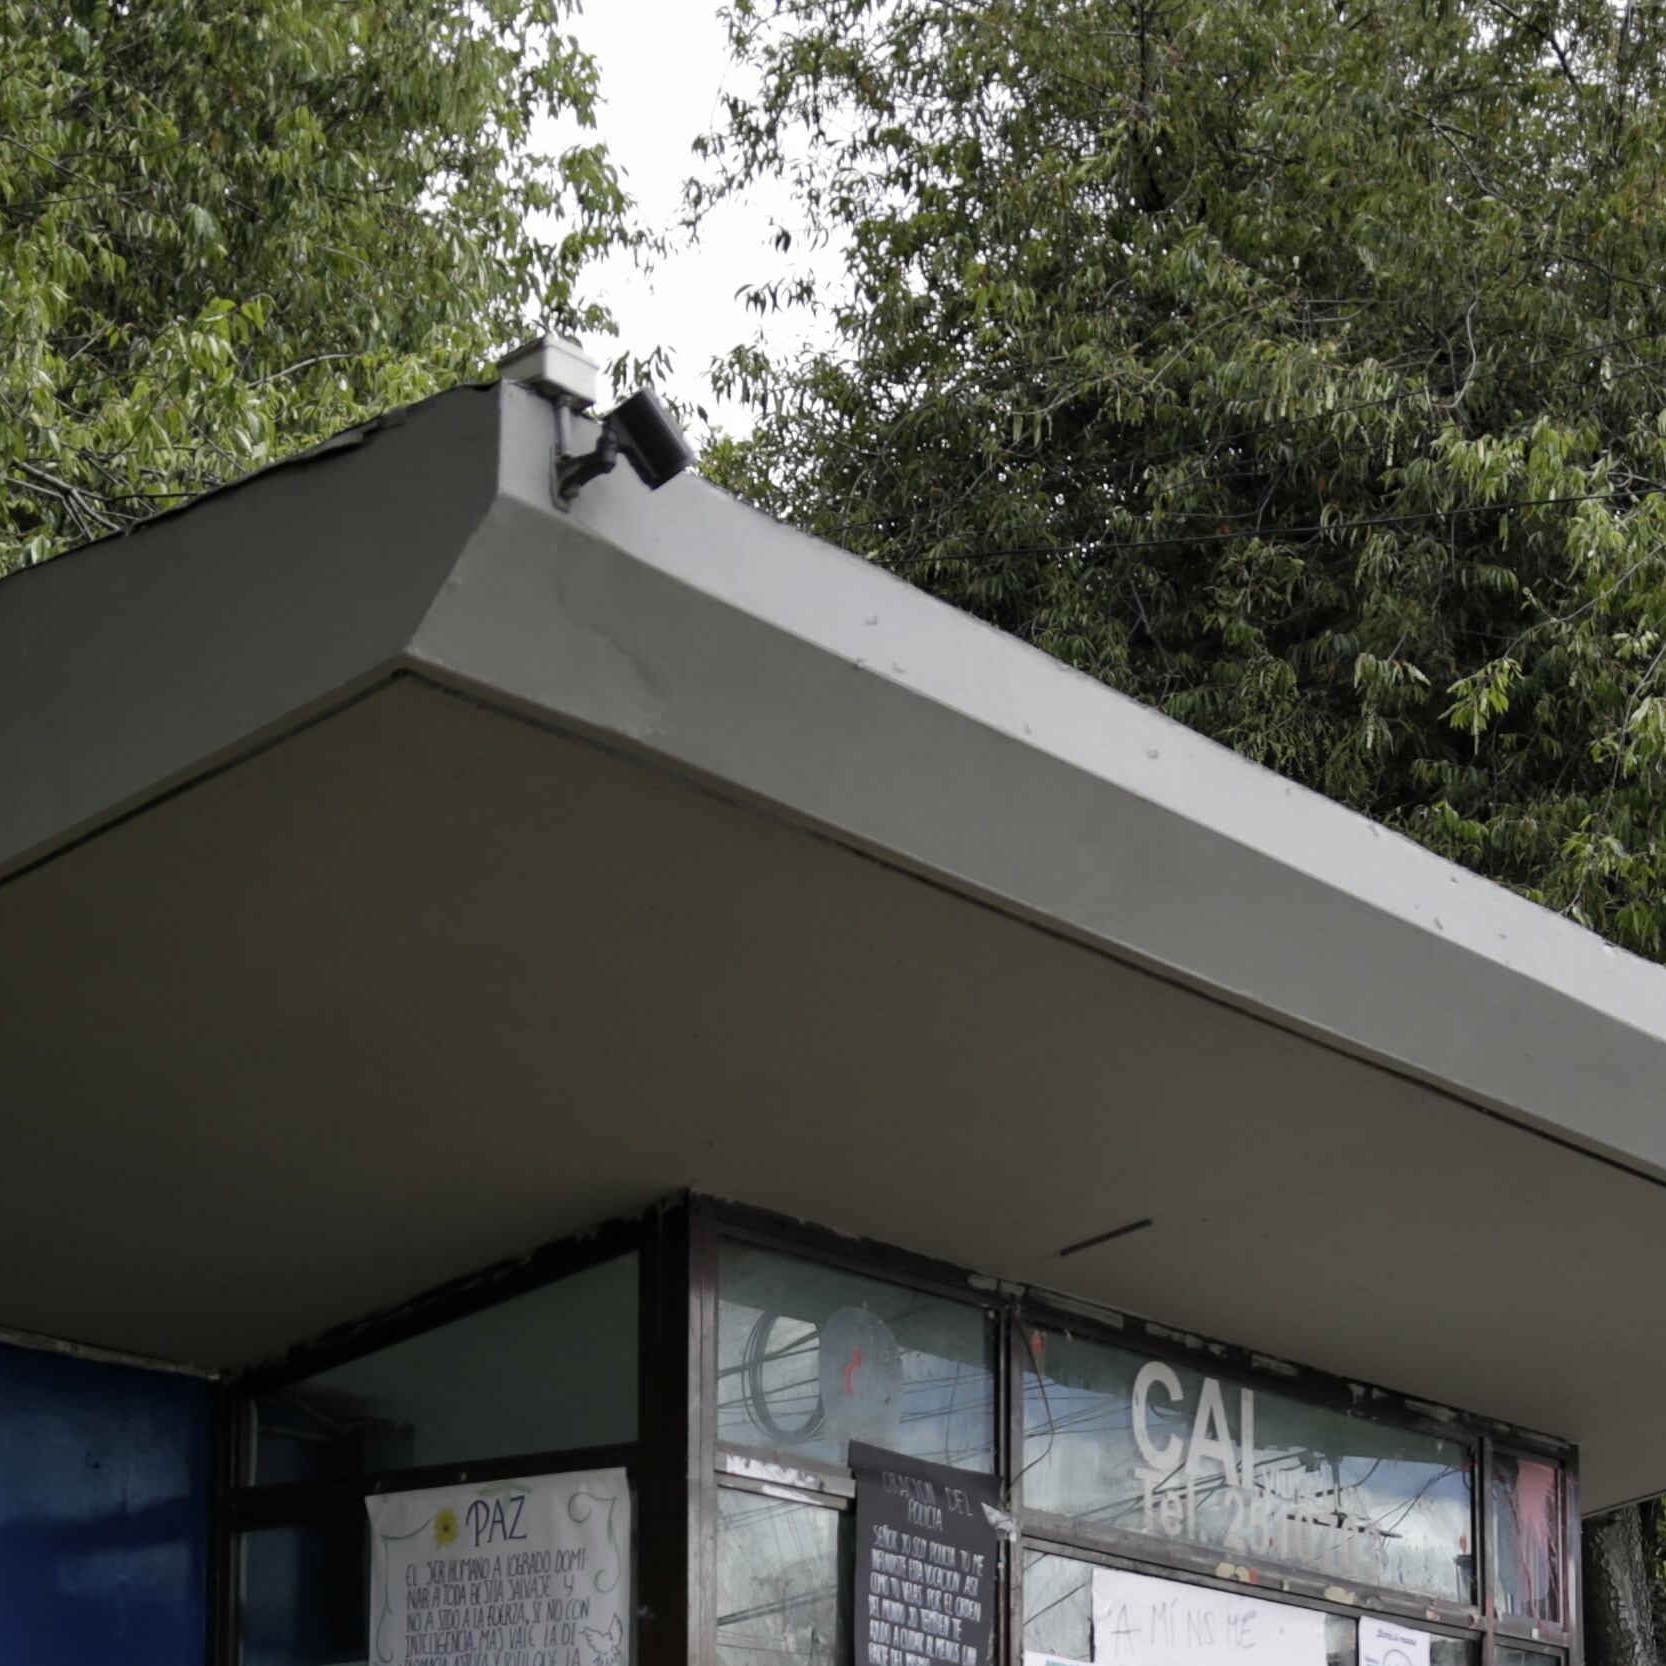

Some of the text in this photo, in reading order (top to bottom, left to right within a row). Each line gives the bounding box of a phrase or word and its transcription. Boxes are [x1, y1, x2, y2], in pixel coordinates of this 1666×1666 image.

[1132, 1361, 1254, 1488] CAI
[909, 1499, 943, 1531] POLICIA
[945, 1486, 973, 1516] DEL
[466, 1495, 527, 1547] PAZ
[406, 1564, 417, 1586] EL
[426, 1562, 445, 1586] SER
[447, 1558, 489, 1584] HUMANO
[493, 1556, 502, 1579] A
[506, 1550, 551, 1578] LOGRADO
[406, 1575, 573, 1610] NAR A TODA BESTIA SALVAJE Y
[406, 1611, 421, 1632] NO
[424, 1611, 433, 1630] A
[438, 1608, 459, 1629] SIDO
[462, 1608, 469, 1627] A
[473, 1607, 483, 1627] LA
[546, 1600, 562, 1622] NO
[565, 1598, 589, 1620] CON
[1111, 1604, 1141, 1658] A
[1227, 1612, 1258, 1649] ME
[479, 1630, 503, 1651] MAS
[509, 1625, 534, 1649] VALE
[544, 1624, 556, 1647] LA
